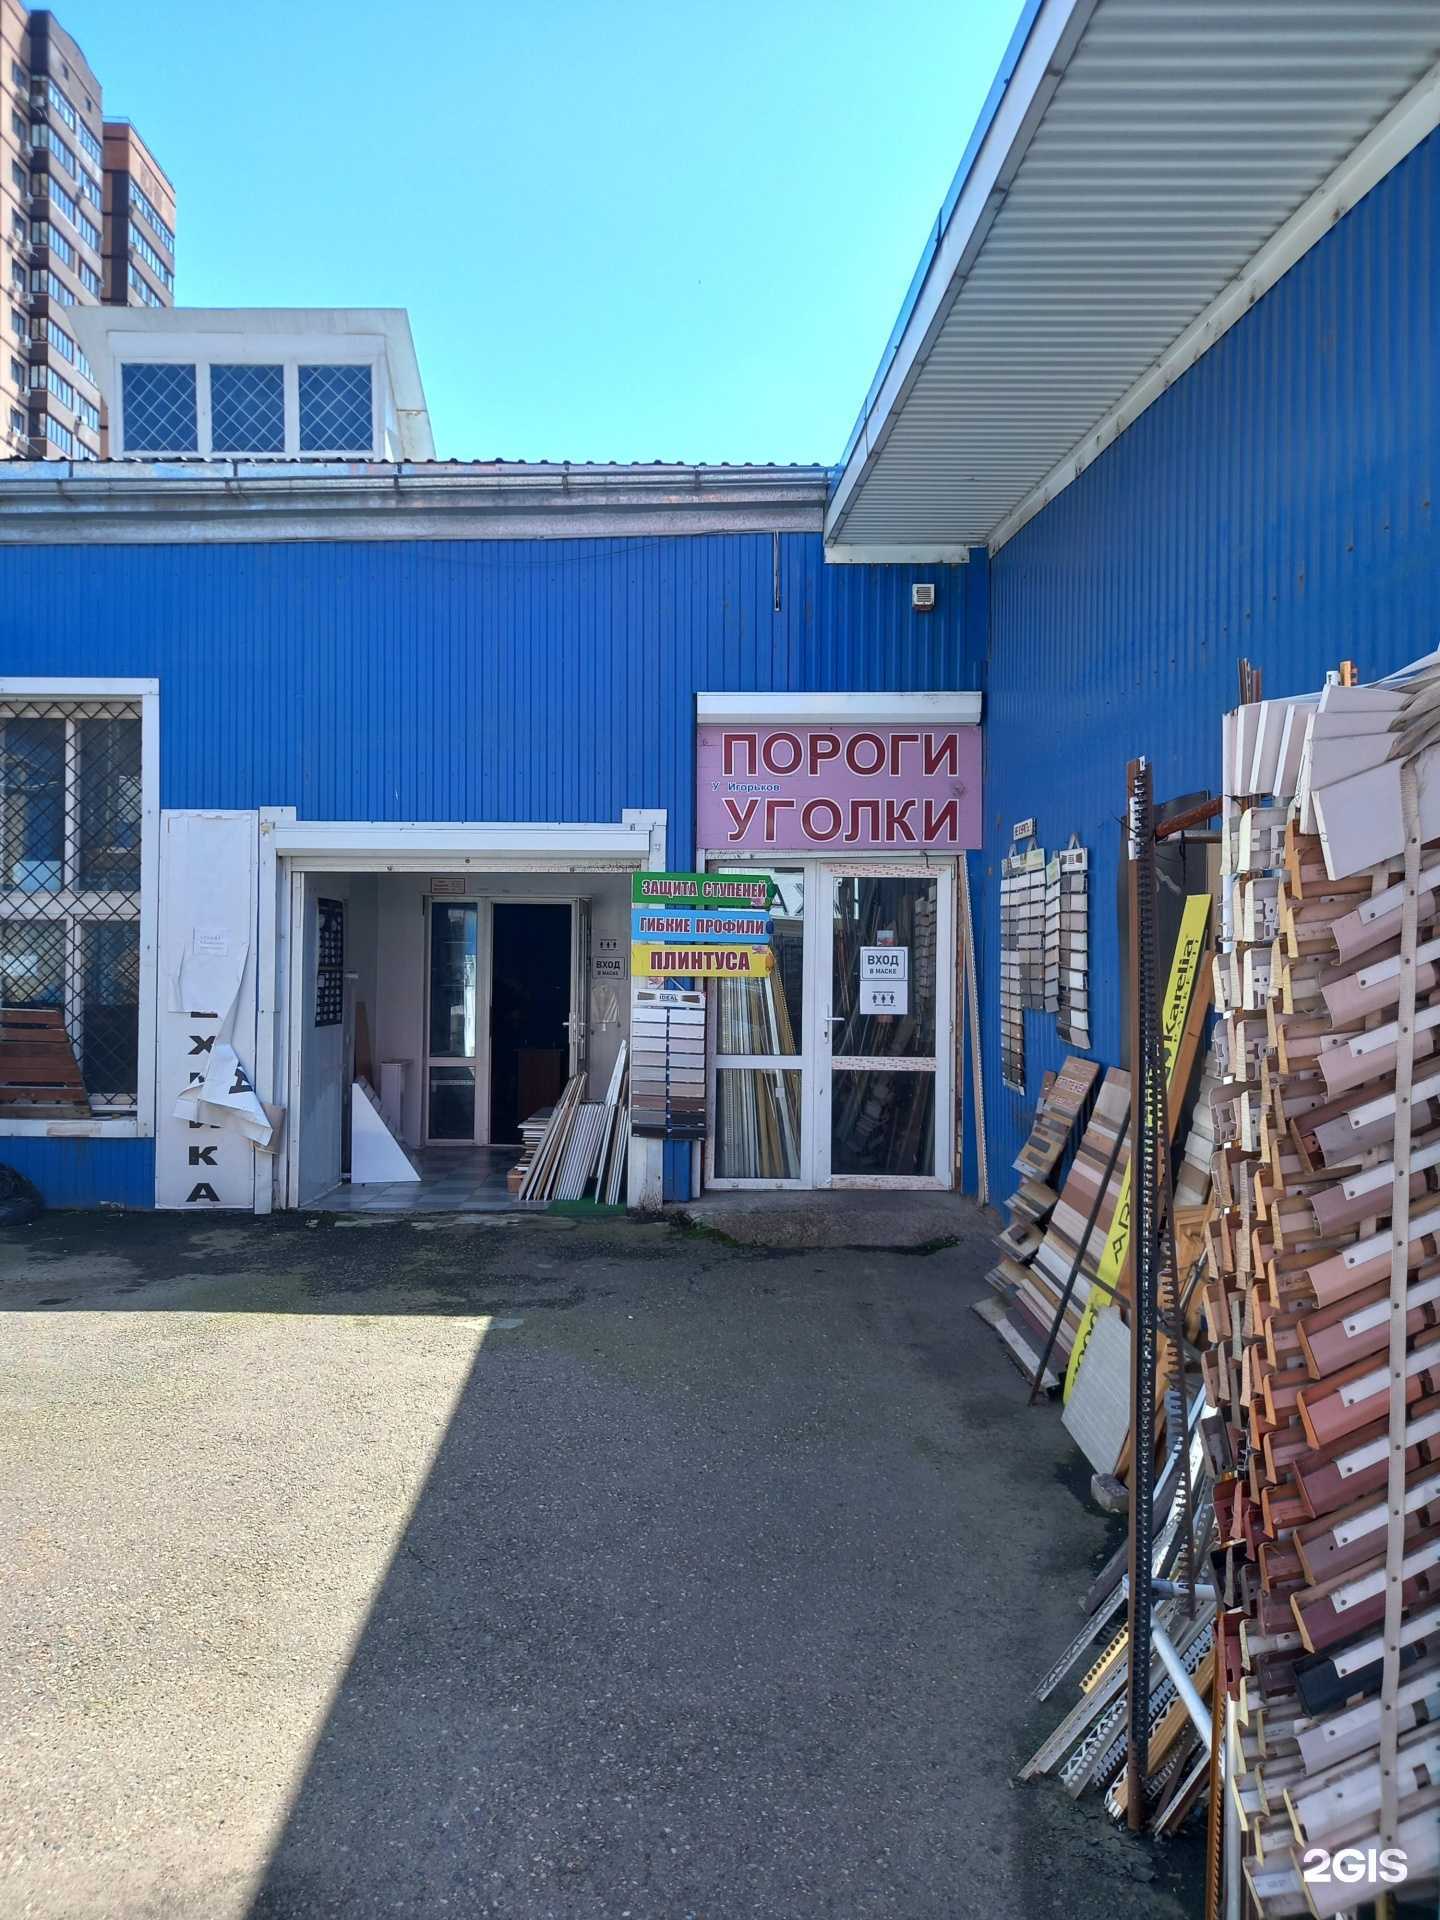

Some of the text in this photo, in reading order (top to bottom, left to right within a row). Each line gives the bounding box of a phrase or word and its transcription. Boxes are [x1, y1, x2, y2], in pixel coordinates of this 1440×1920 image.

[721, 732, 959, 777] ПОРОГИ
[728, 782, 780, 792] Игорьков
[721, 796, 960, 843] УГОЛКИ
[641, 879, 698, 898] ЗАЩИТА
[703, 880, 768, 898] СТУПЕНЕЙ
[640, 917, 765, 935] ГИБКИЕ ПРОФИЛИ
[596, 960, 621, 970] ВХОД
[650, 951, 750, 970] ПЛИНТУСА
[867, 955, 899, 967] ВХОД
[1163, 939, 1194, 1042] Karelia
